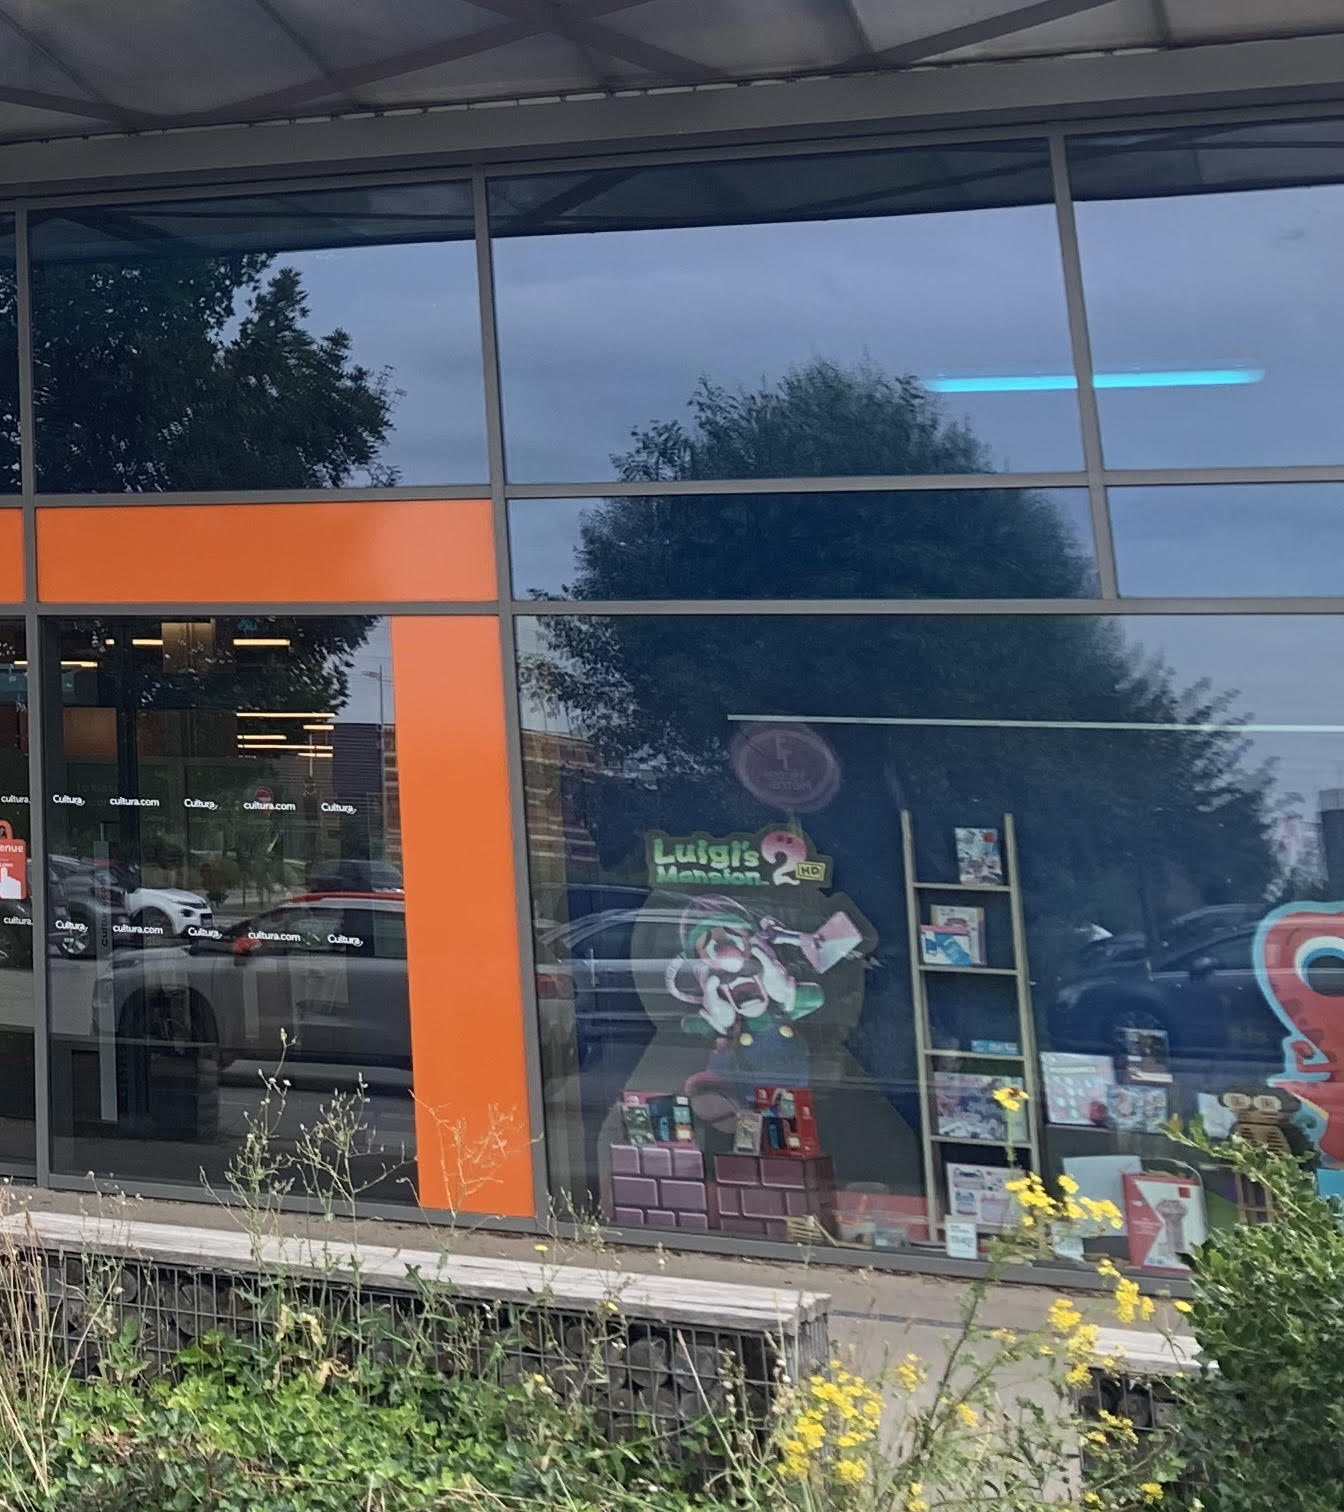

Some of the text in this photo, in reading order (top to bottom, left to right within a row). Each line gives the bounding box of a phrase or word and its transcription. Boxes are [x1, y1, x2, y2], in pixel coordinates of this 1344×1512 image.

[0, 794, 31, 804] cultura.
[52, 794, 357, 814] Cultura cultura.com Cultura cultura.com Cultura
[654, 830, 807, 886] Luigi's 2
[656, 865, 820, 885] Mansion HD
[3, 915, 33, 925] cultura.
[55, 920, 363, 947] Cultura cultura.com Cultura cultura.com Cultura
